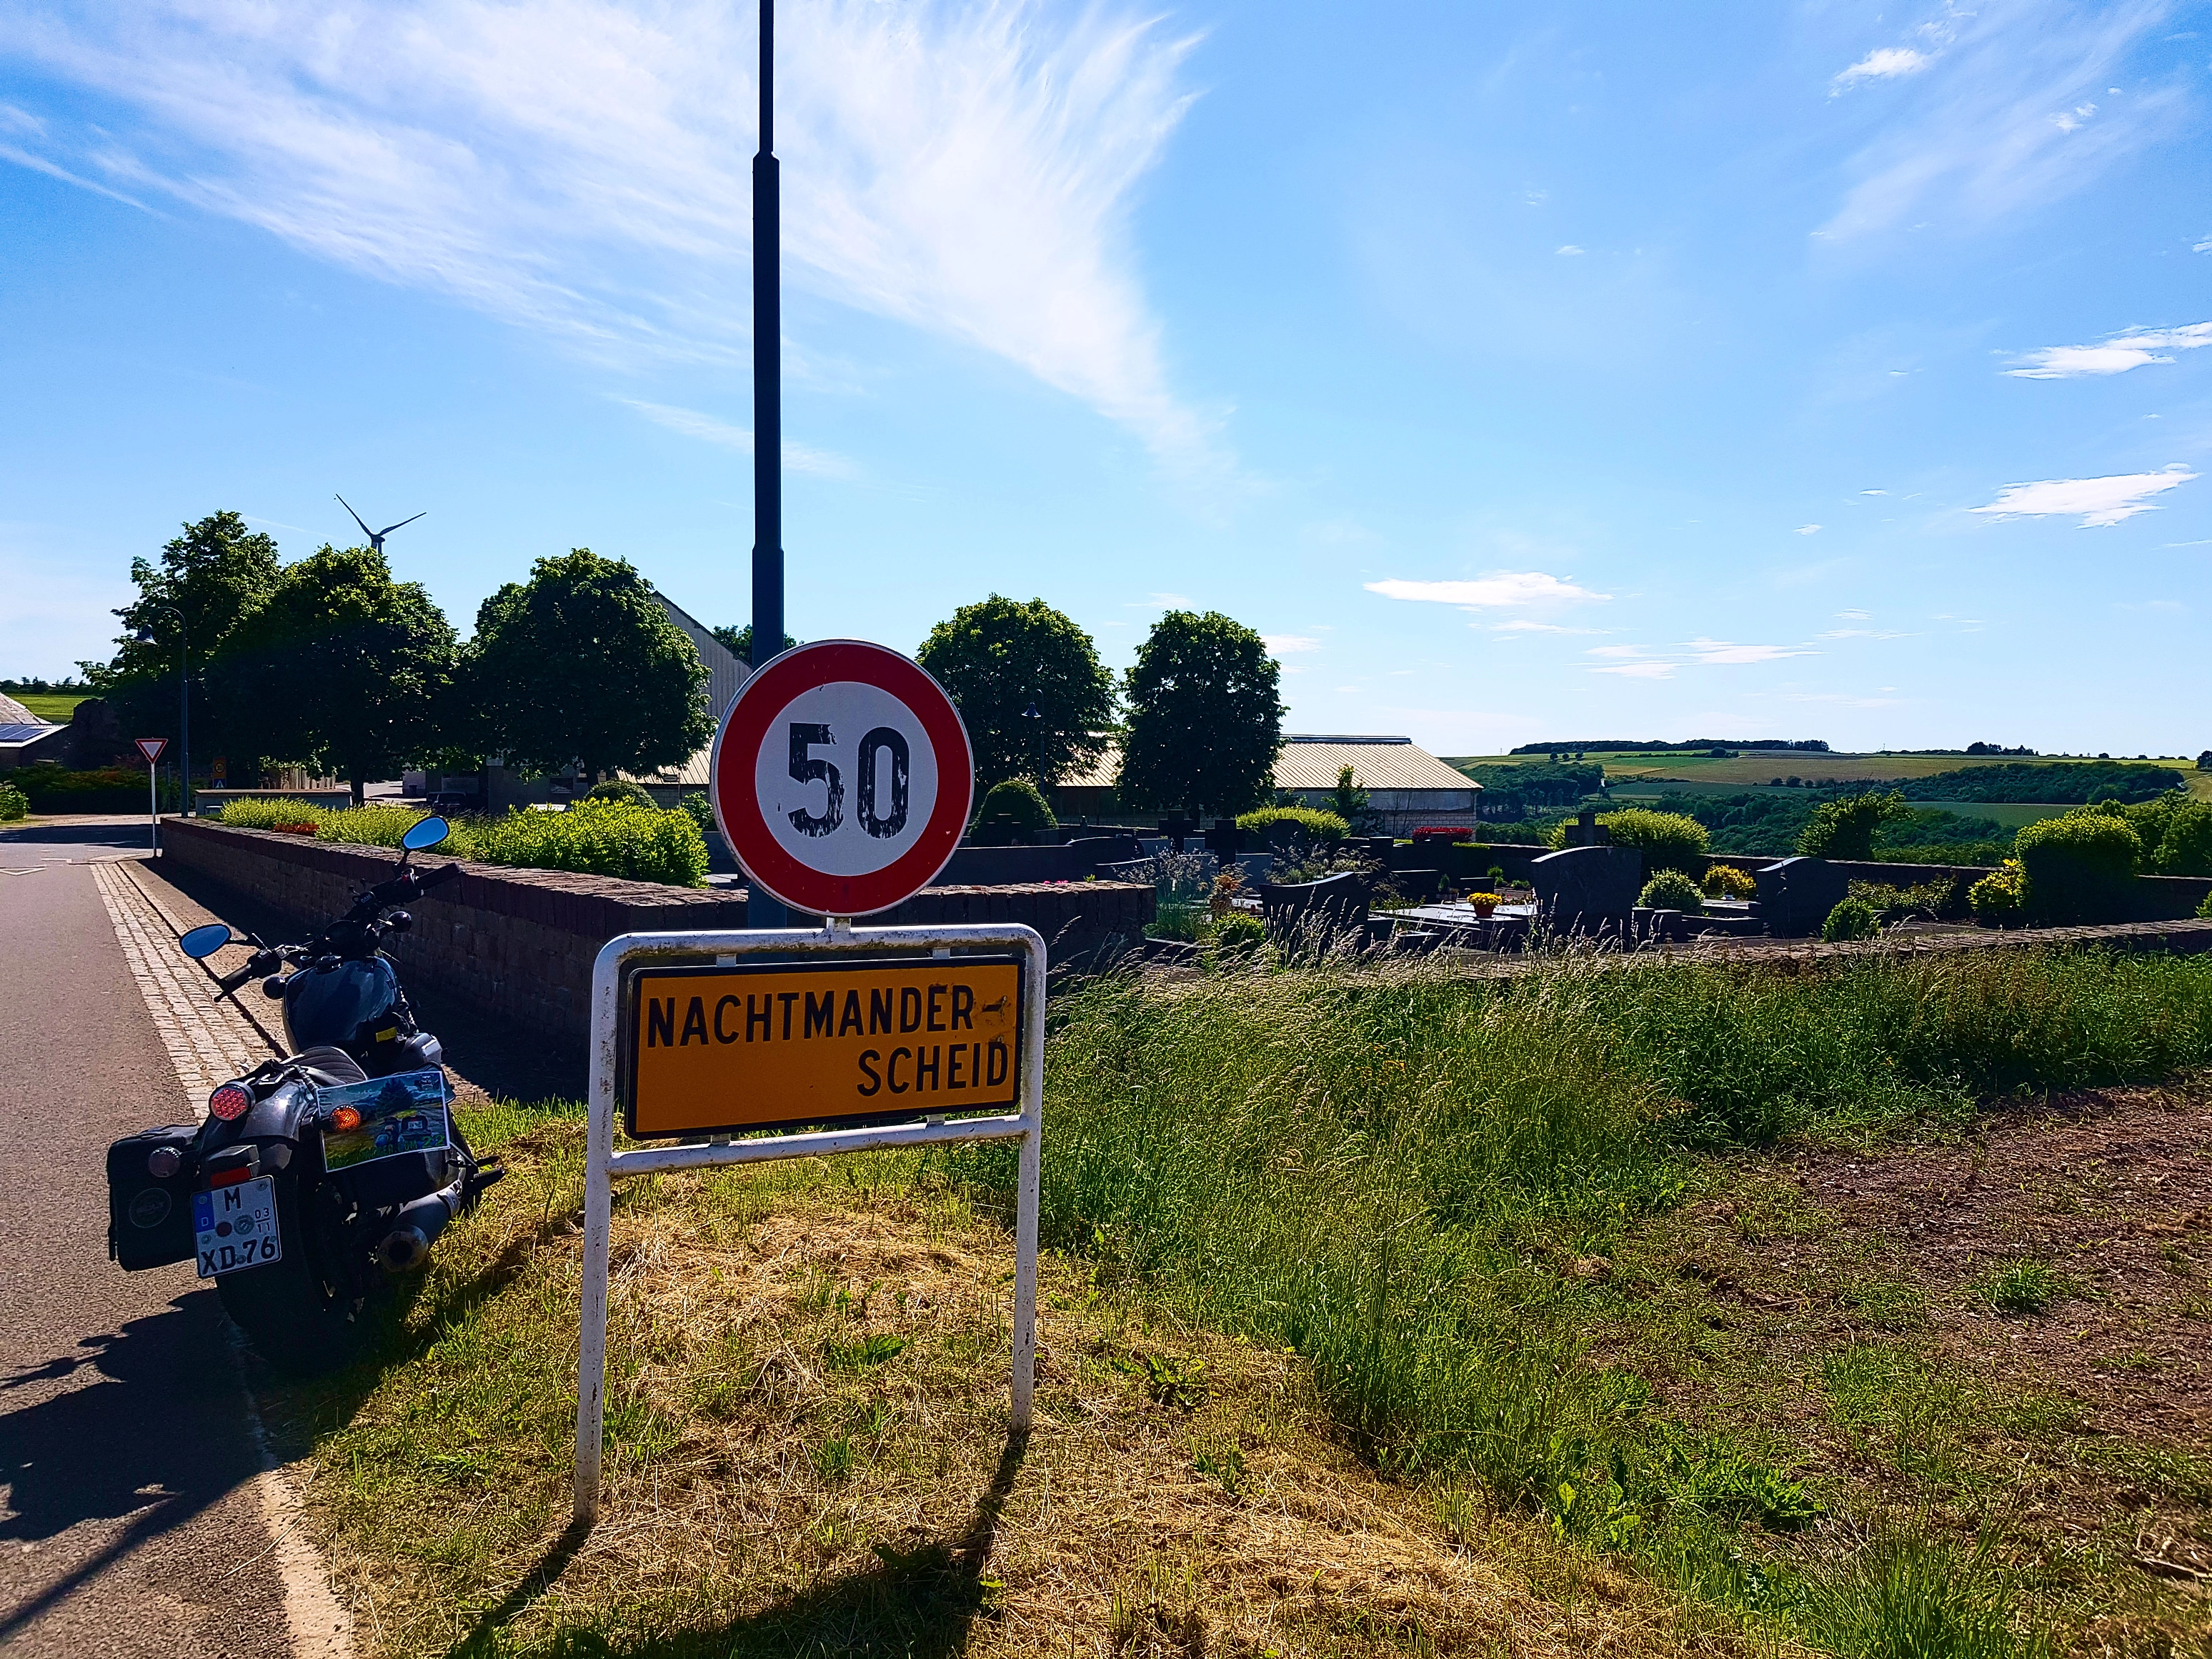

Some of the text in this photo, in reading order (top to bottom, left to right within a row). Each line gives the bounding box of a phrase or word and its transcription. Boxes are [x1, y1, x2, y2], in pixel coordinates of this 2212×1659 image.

[787, 722, 910, 840] 50
[647, 985, 1008, 1048] NACHTMANDER-
[857, 1042, 1008, 1097] SCHEID
[420, 1133, 446, 1147] 22
[224, 1187, 241, 1212] M
[201, 1217, 209, 1226] D
[254, 1207, 270, 1219] 03
[257, 1222, 271, 1233] 11
